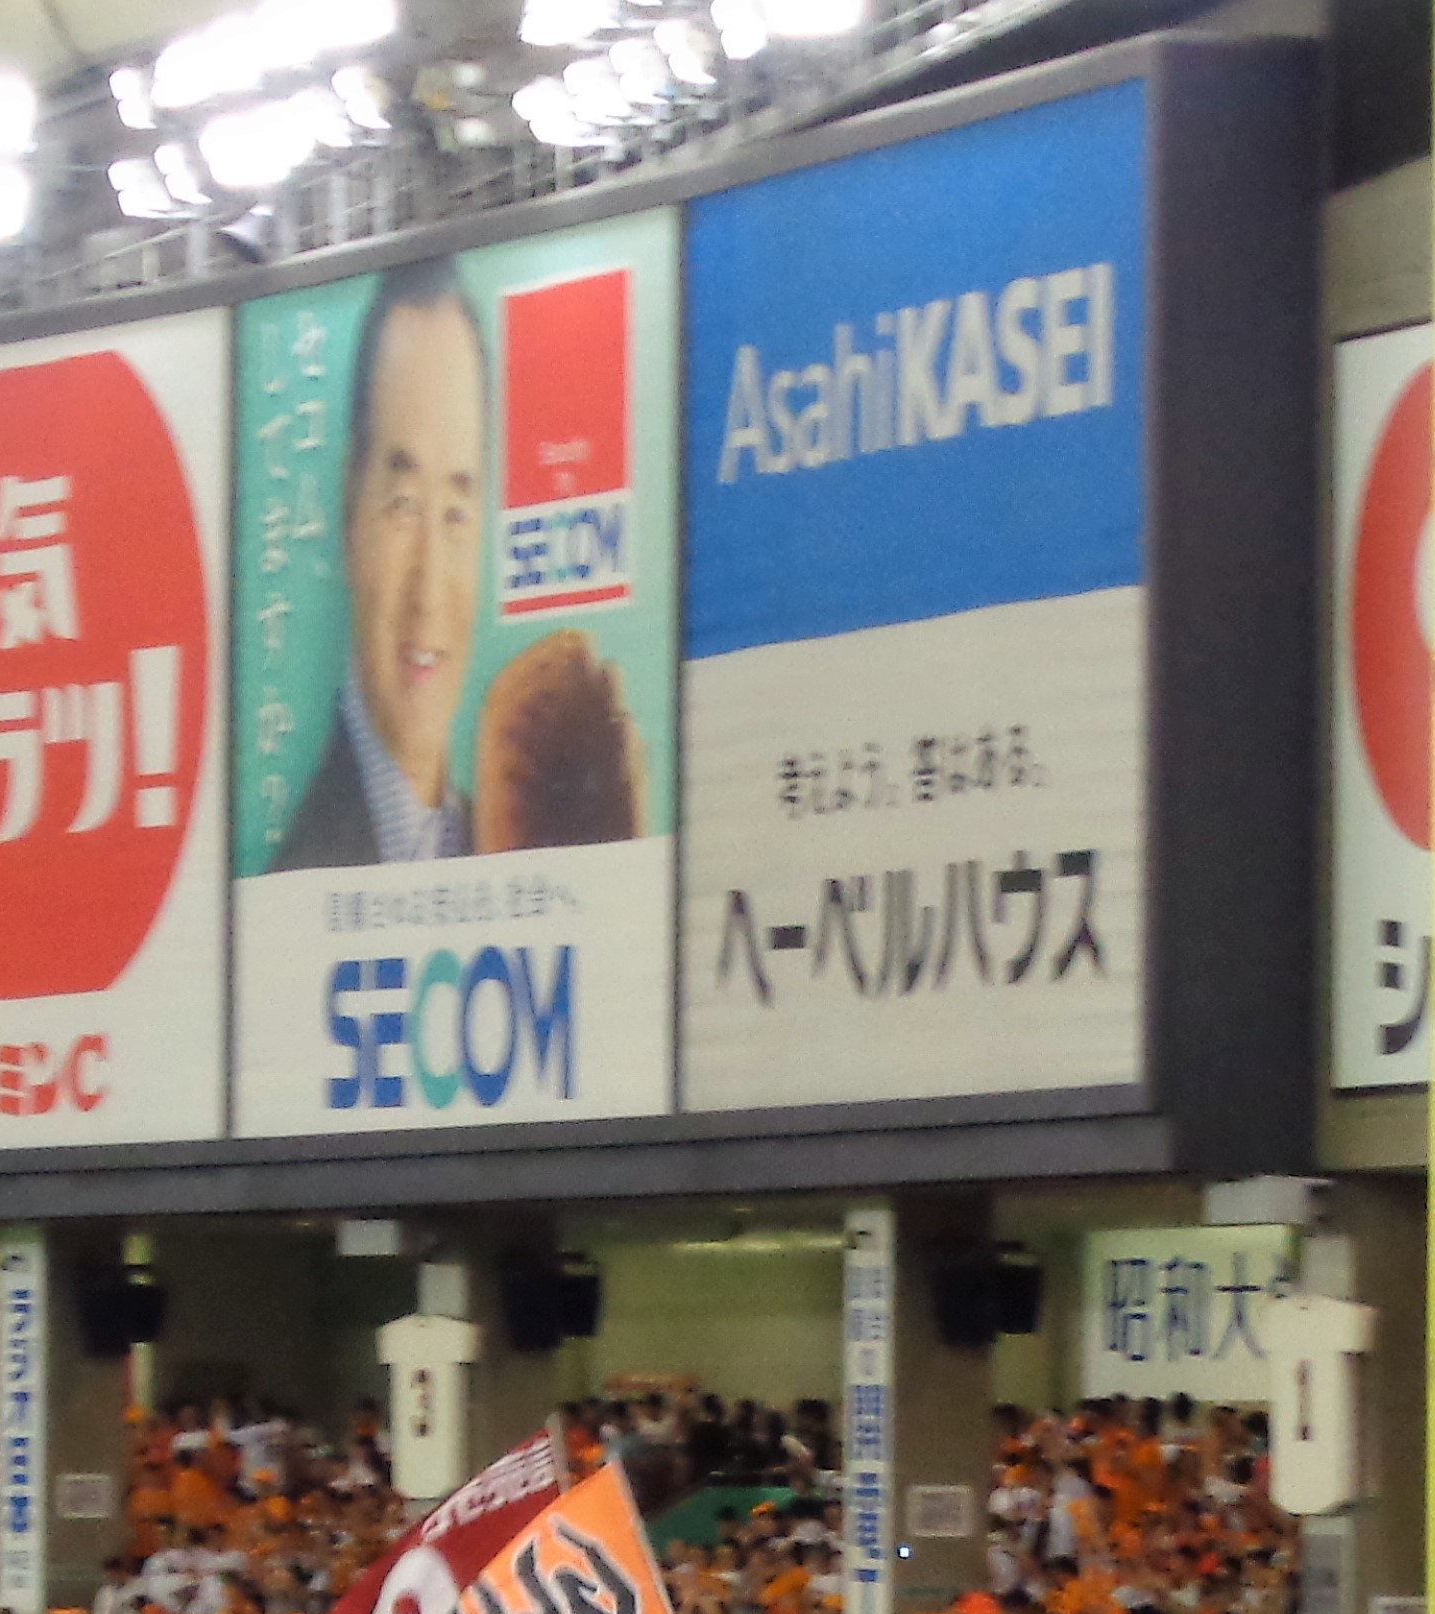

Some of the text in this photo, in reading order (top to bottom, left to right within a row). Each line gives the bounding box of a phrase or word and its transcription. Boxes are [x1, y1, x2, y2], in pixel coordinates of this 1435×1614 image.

[715, 848, 1107, 1009] ヘーベルハウス
[324, 944, 576, 1110] SECOM
[1105, 1251, 1291, 1362] 昭和大
